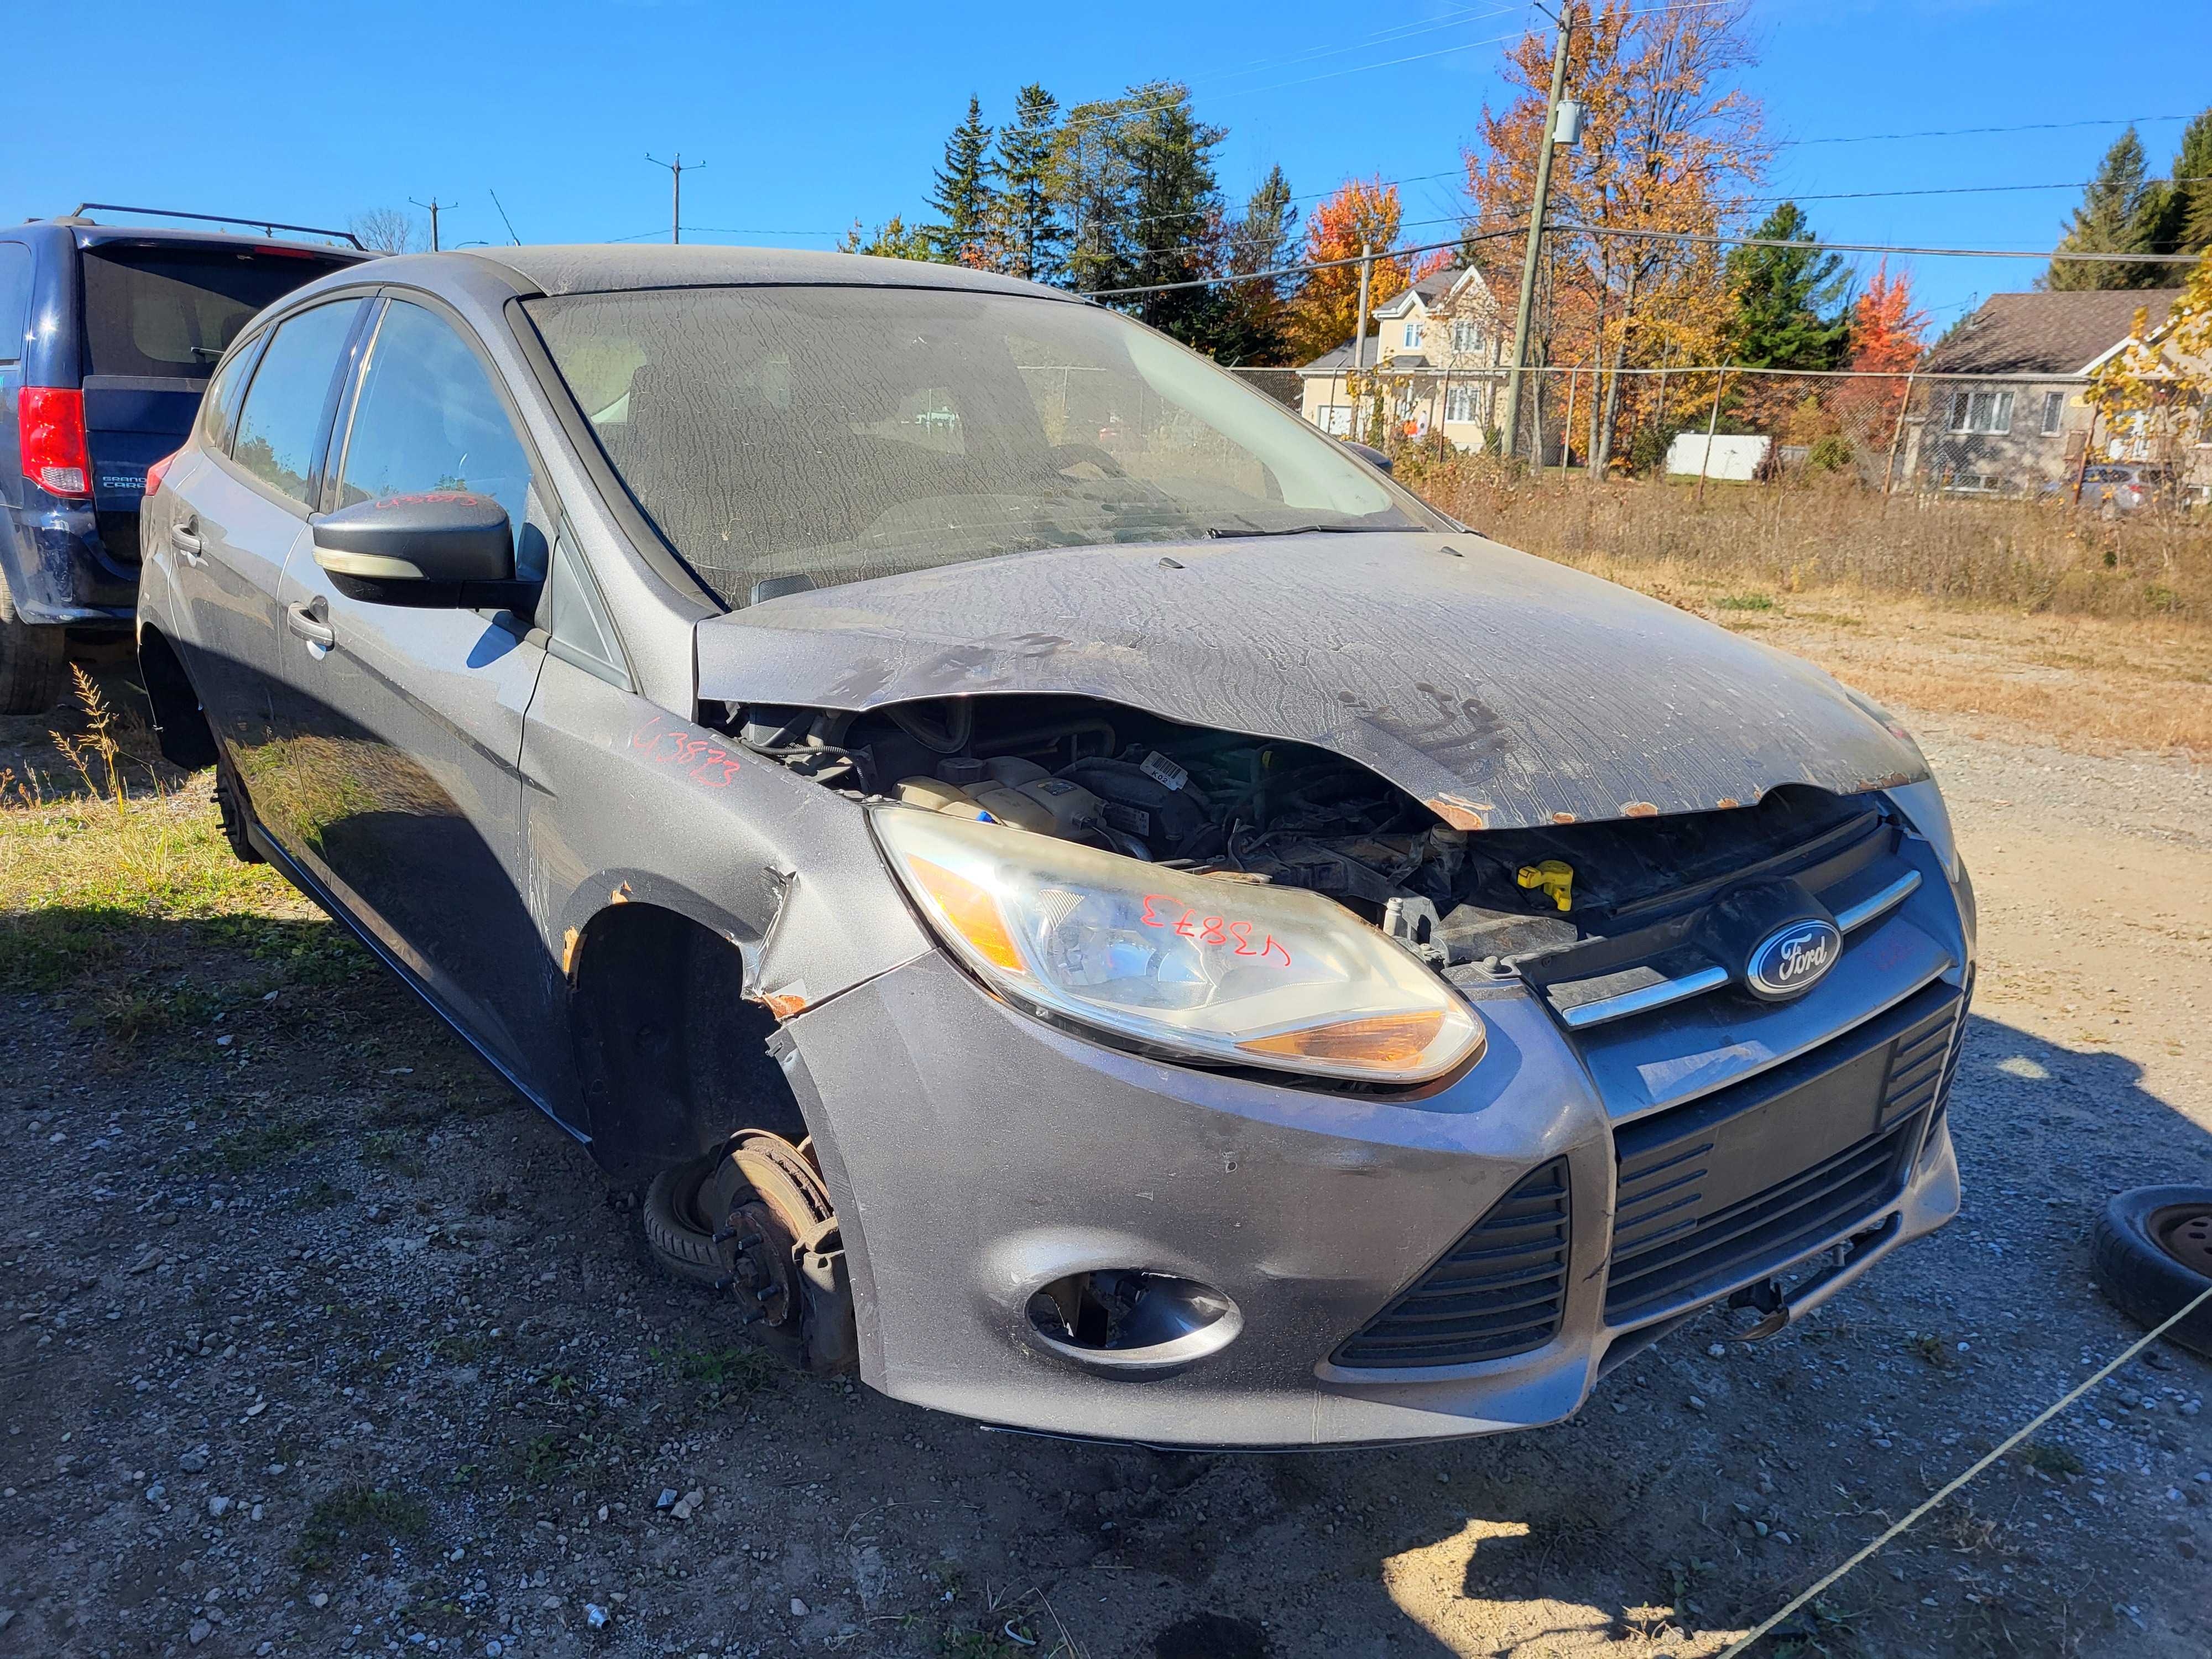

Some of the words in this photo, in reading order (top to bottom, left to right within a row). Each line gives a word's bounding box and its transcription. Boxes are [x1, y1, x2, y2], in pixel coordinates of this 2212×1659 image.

[634, 716, 740, 787] 43873
[1151, 770, 1168, 784] K02
[1141, 894, 1291, 967] 43873
[1778, 933, 1827, 980] Ford
